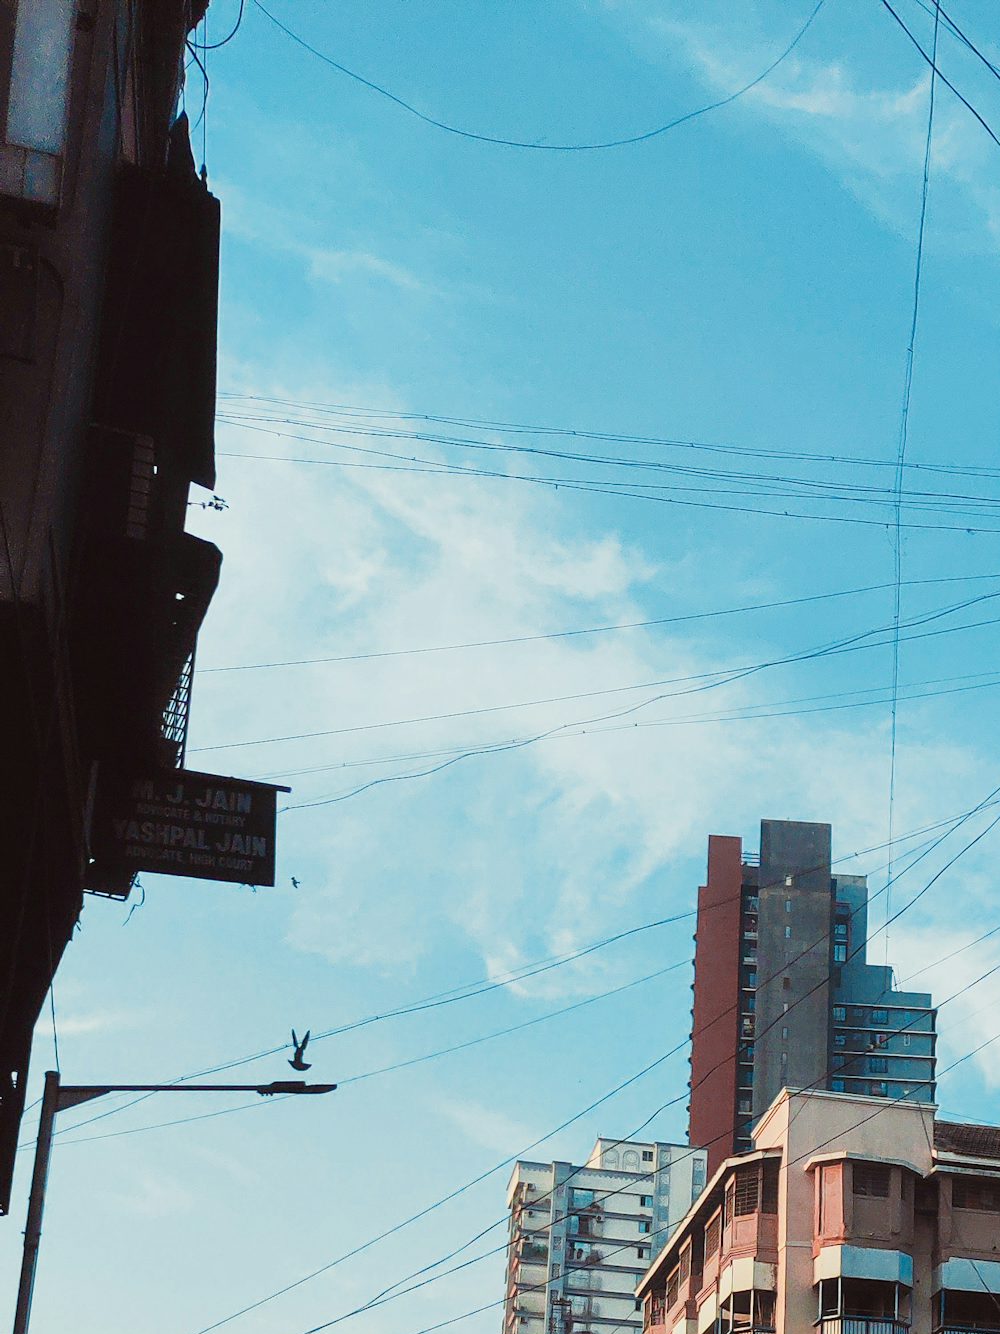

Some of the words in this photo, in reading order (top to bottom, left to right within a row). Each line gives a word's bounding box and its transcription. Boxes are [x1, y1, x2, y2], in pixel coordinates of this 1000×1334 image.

[166, 784, 190, 806] J.
[195, 787, 253, 815] JAIN
[111, 818, 212, 852] YASHPAL
[214, 831, 268, 859] JAIN
